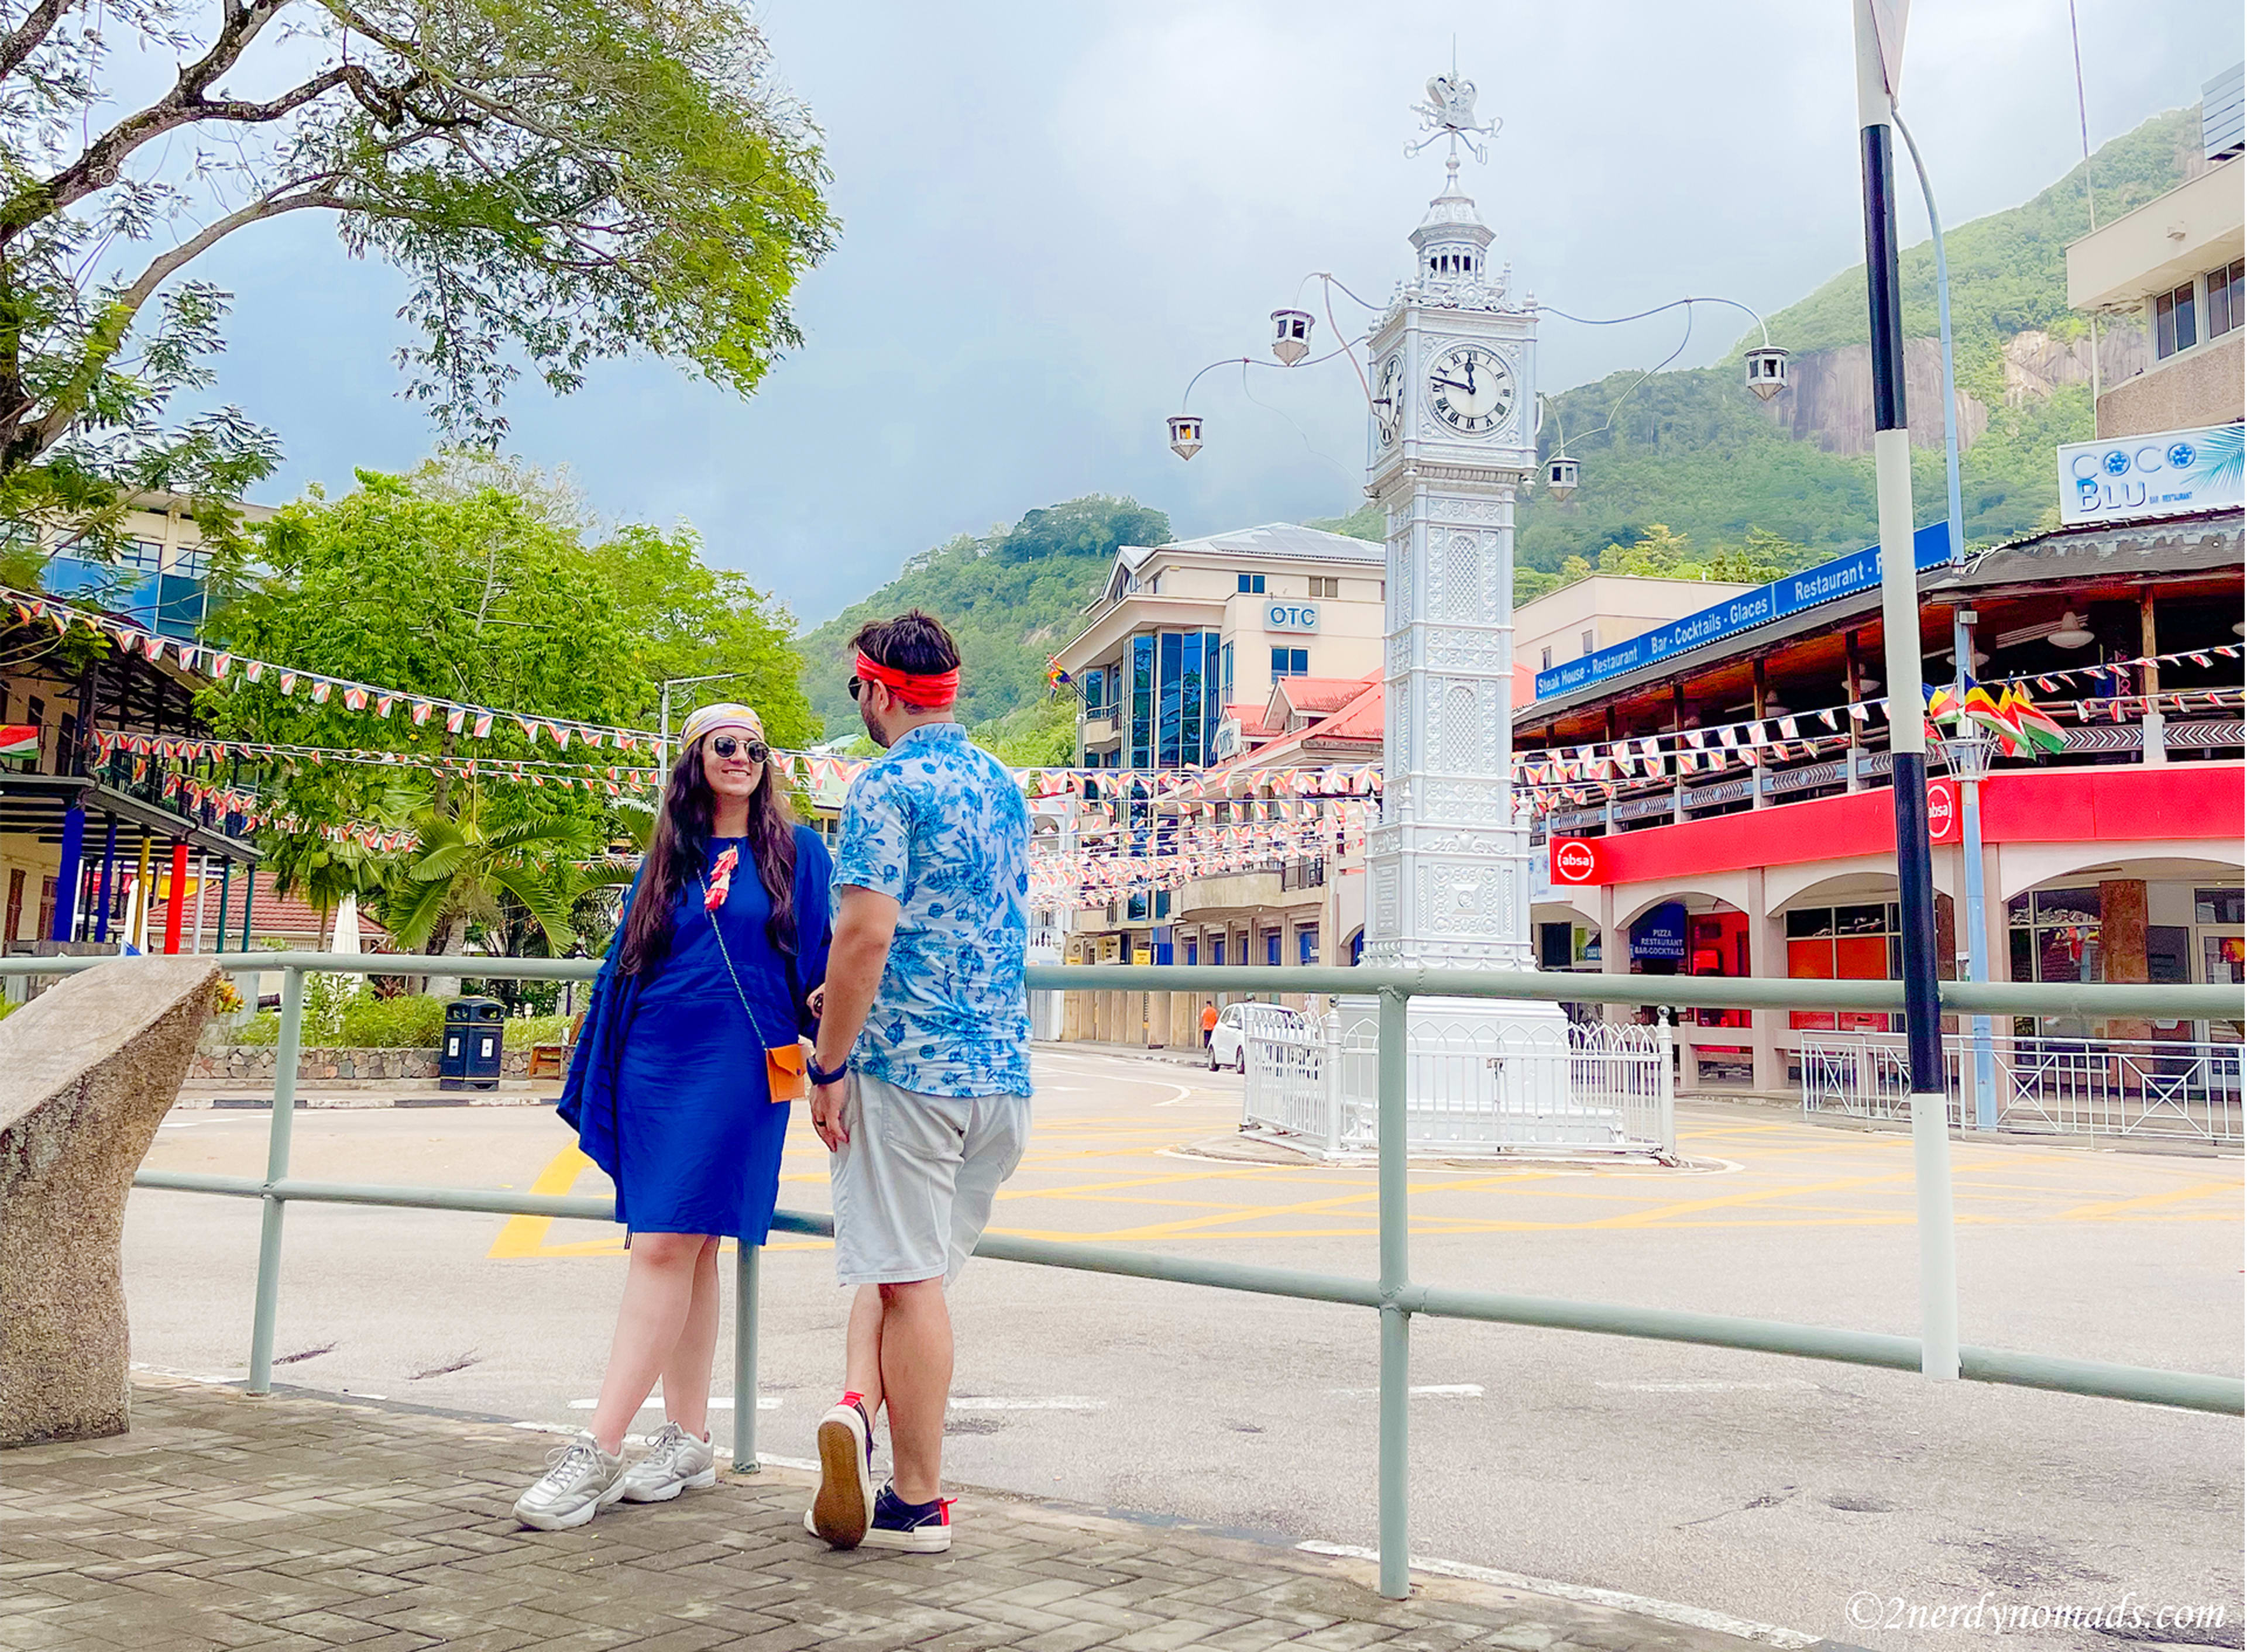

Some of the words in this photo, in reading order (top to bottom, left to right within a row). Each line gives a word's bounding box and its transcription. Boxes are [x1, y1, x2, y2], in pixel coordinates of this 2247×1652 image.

[2072, 443, 2196, 480] COCO
[2077, 479, 2146, 512] BLU
[1795, 560, 1864, 602] Restaurant
[1270, 607, 1315, 627] OTC
[1651, 636, 1667, 655] Bar
[1675, 614, 1721, 645] Cocktails
[1730, 598, 1767, 624] Glaces
[1538, 673, 1560, 694] Steak
[1561, 667, 1585, 686] House
[1592, 645, 1638, 675] Restaurant
[1562, 853, 1589, 866] absa
[1641, 938, 1683, 947] RESTAURANT
